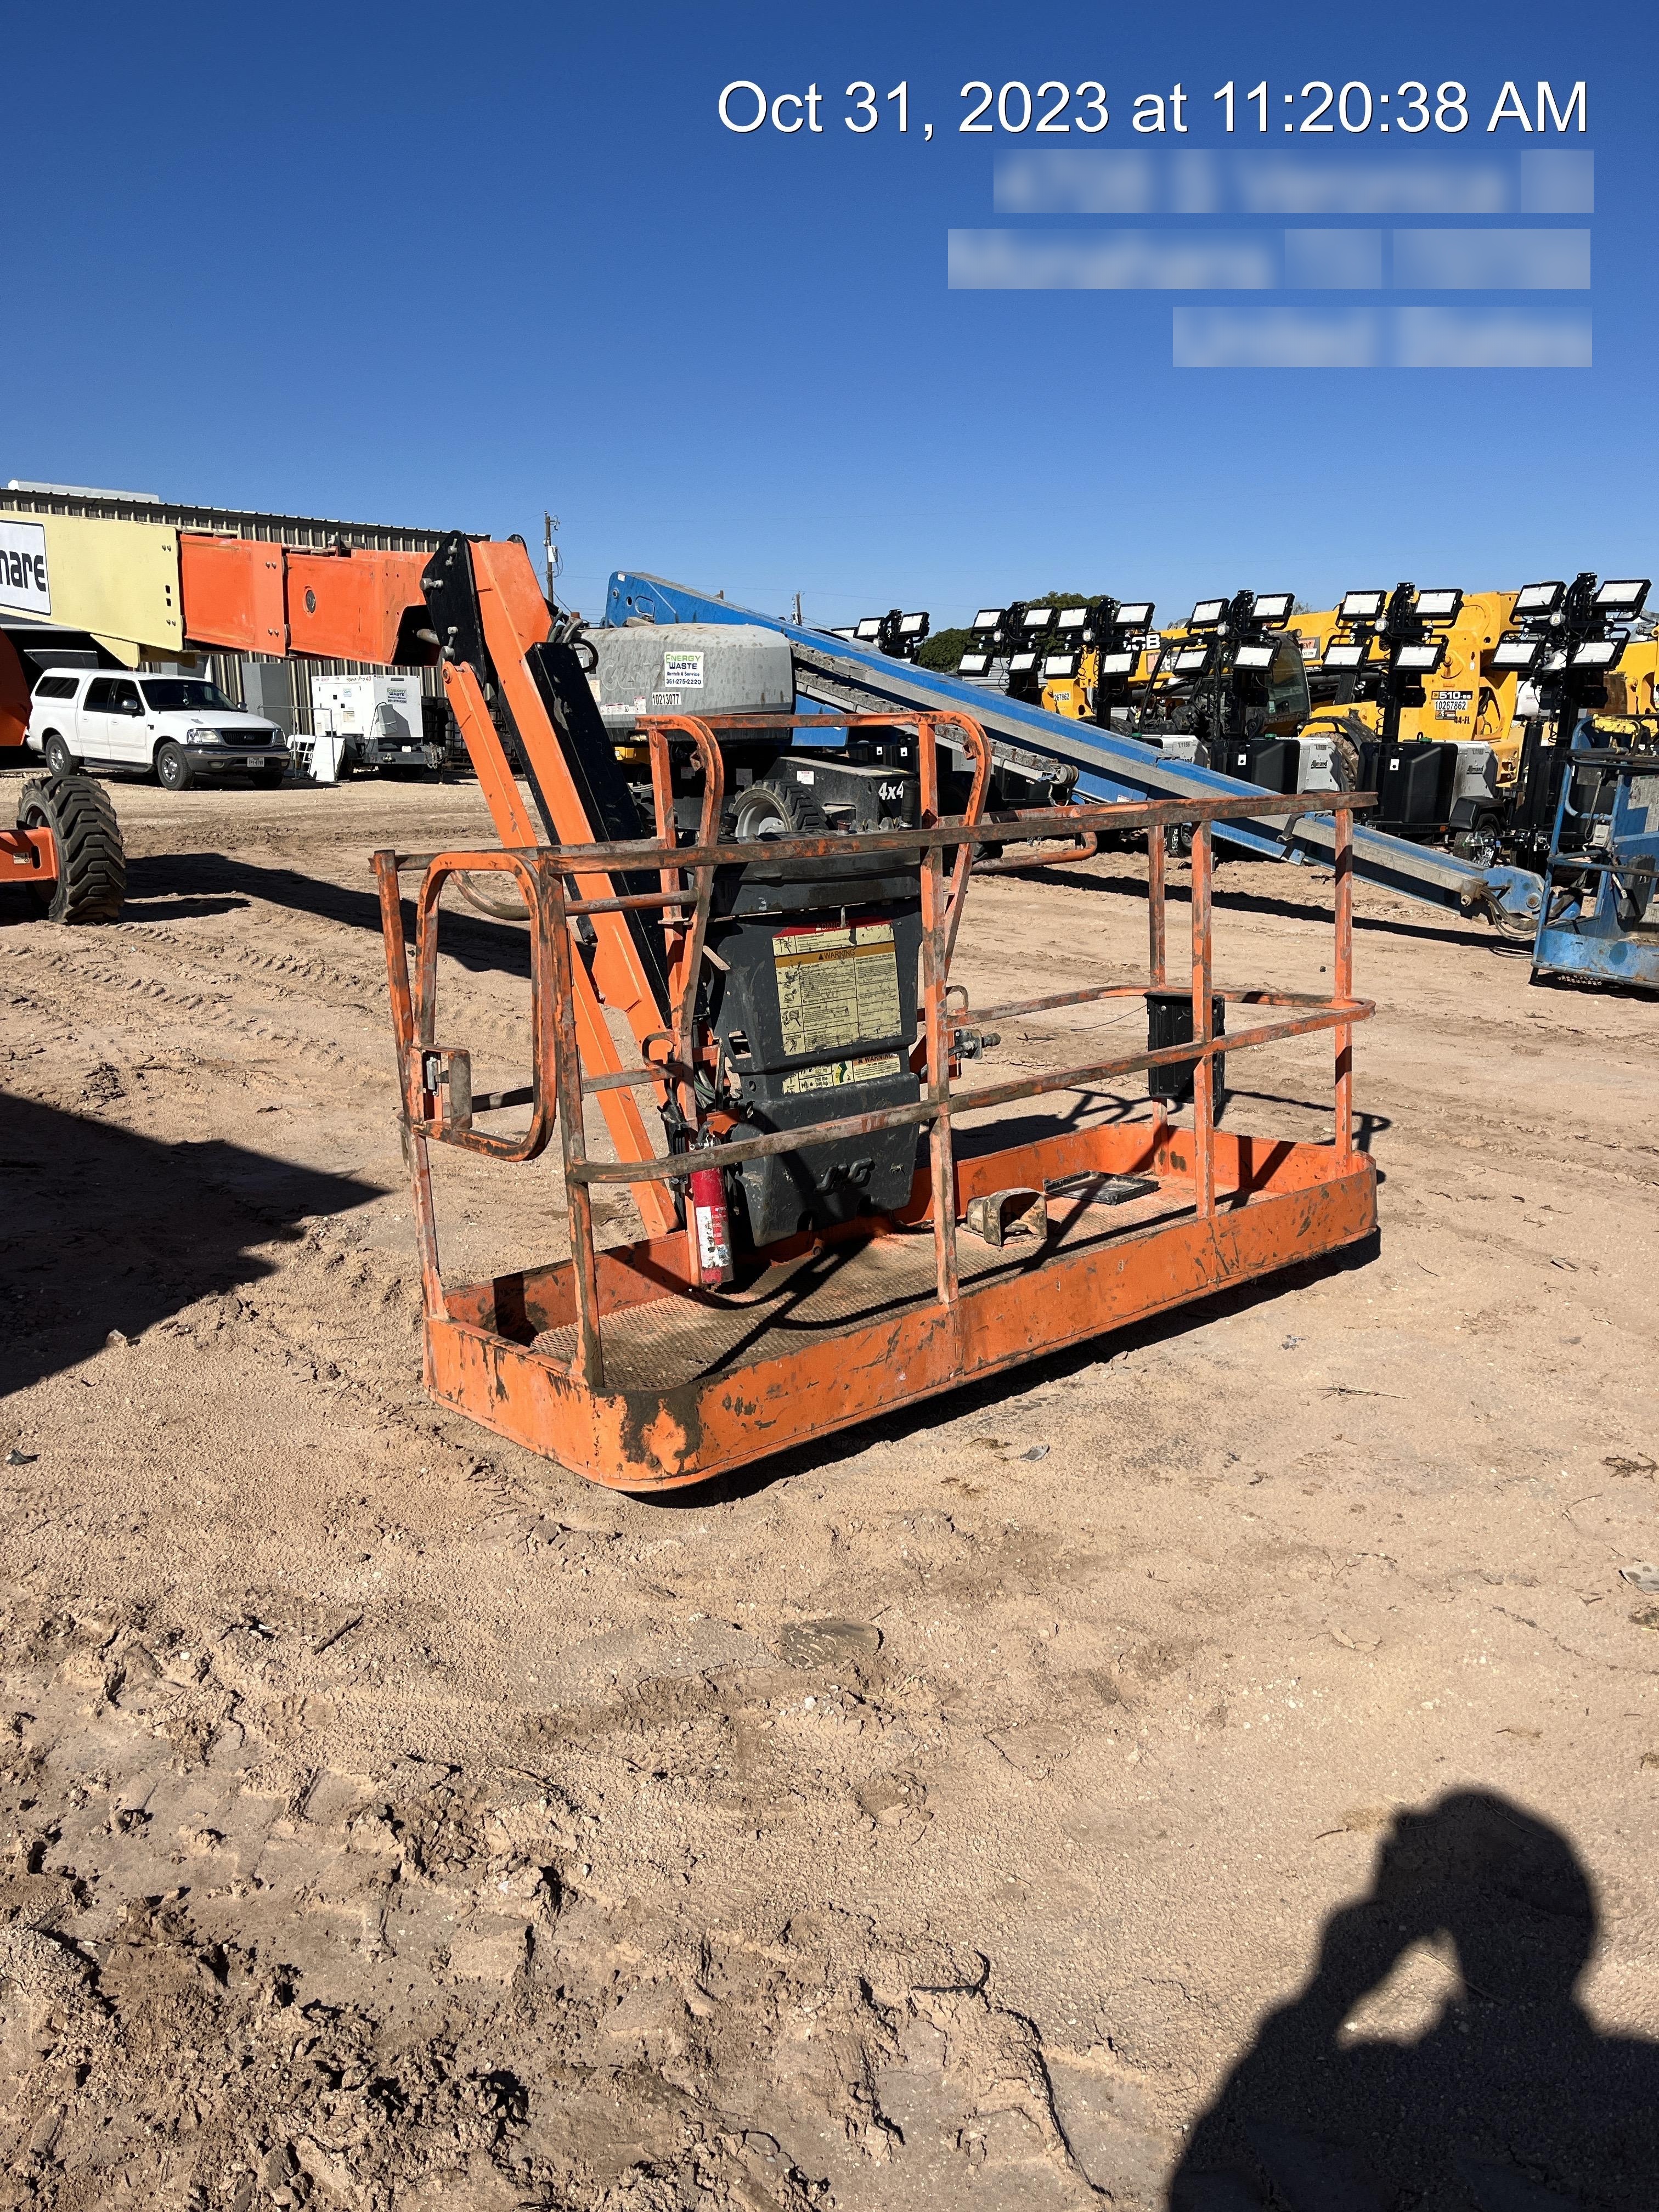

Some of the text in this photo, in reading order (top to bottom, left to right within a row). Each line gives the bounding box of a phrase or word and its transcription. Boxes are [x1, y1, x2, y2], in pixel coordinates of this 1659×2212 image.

[1126, 634, 1160, 651] CB
[666, 654, 701, 664] ENERGY
[669, 662, 698, 670] WASTE
[652, 693, 680, 706] 10213077
[1435, 701, 1466, 710] 10267862
[878, 781, 904, 800] 4x4
[821, 921, 850, 930] DANGR
[823, 950, 855, 960] WARNING
[864, 1053, 894, 1063] WARNING
